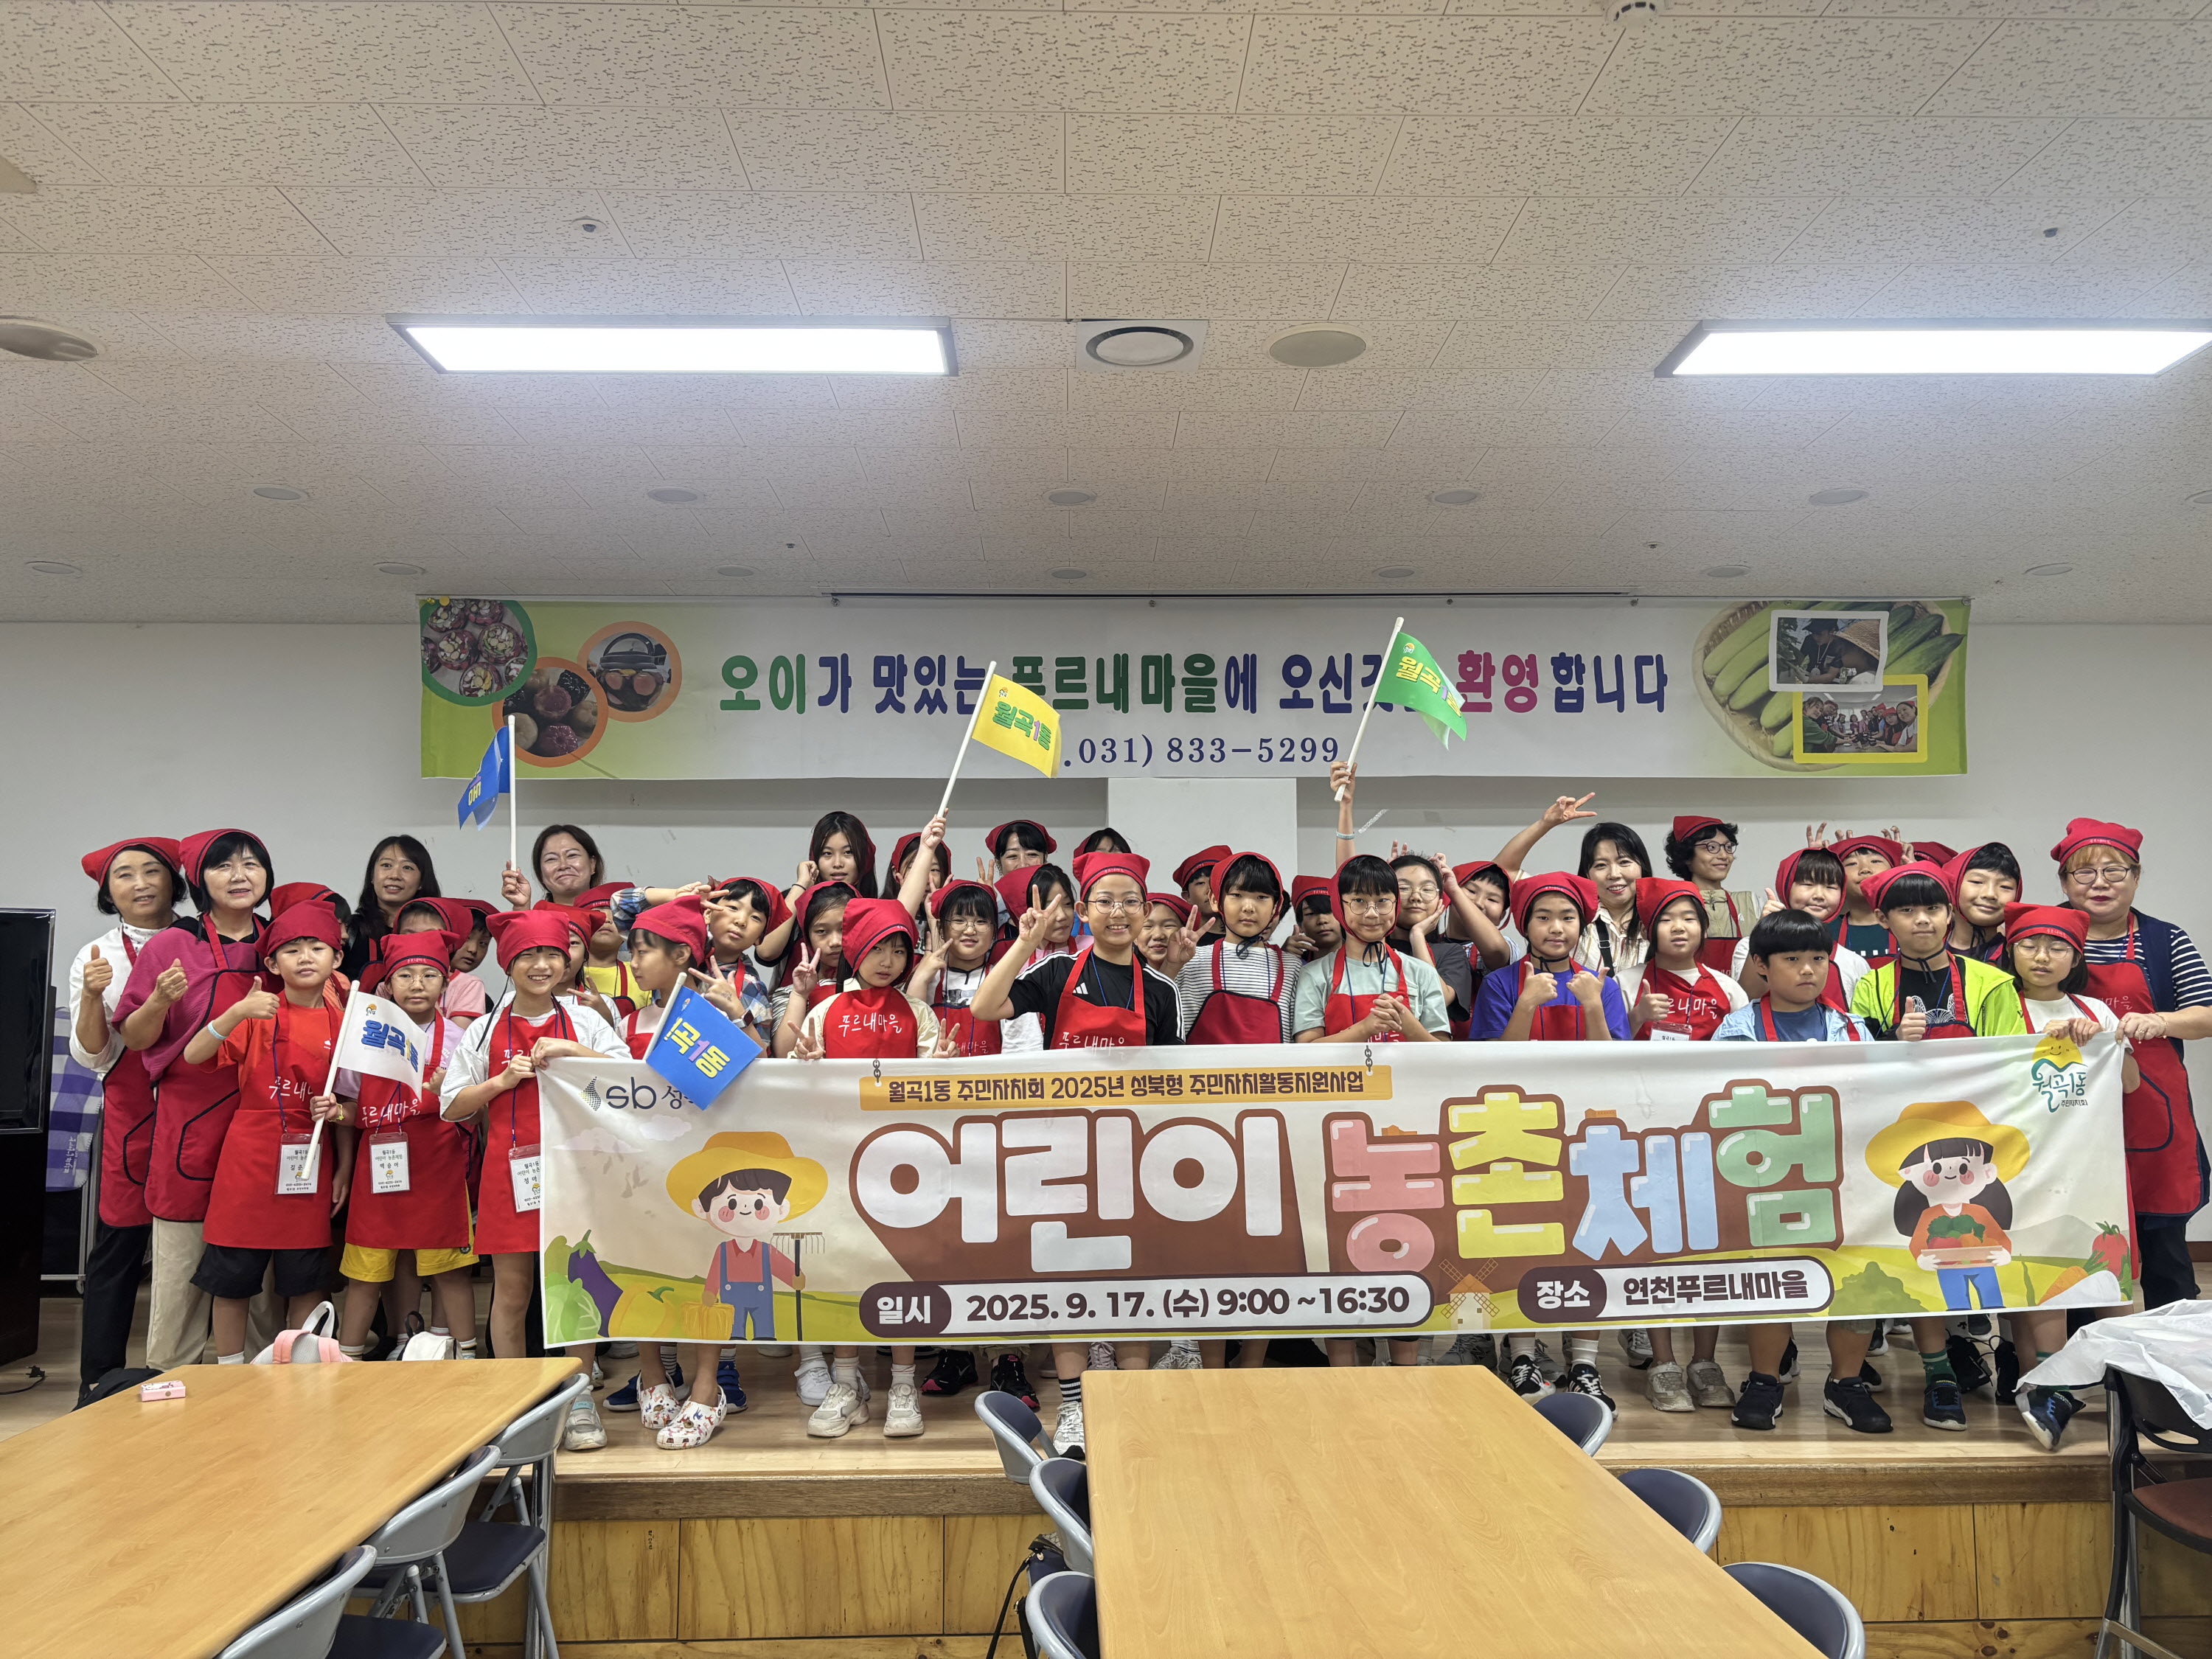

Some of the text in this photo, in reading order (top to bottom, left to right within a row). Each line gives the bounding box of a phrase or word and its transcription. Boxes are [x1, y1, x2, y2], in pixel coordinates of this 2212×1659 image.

[720, 653, 852, 714] 오이가
[872, 653, 987, 715] 맛있는
[1011, 653, 1257, 714] 푸르내마을에
[1455, 649, 1668, 714] 환영합니다
[992, 700, 1052, 751] 월곡1동
[1166, 737, 1339, 764] 833-5299
[838, 1012, 902, 1037] 푸르내마을
[1667, 998, 1718, 1020] 르내마을
[361, 1020, 419, 1073] 월곡1동
[664, 1018, 731, 1079] 곡1동
[605, 1077, 657, 1110] sb
[888, 1071, 1364, 1103] 월곡1동 주민자치회 2025년 성북형 주민자치활동지원사업
[2031, 1071, 2087, 1113] 월곡1동
[2060, 1099, 2088, 1107] 주민자치회
[361, 1098, 421, 1129] 푸르내마을
[855, 1085, 1838, 1273] 어린이 농촌체험
[875, 1295, 931, 1325] 일시
[965, 1294, 1059, 1322] 2025.
[1066, 1293, 1096, 1320] 9.
[1106, 1291, 1155, 1318] 17.
[1162, 1287, 1209, 1319] (수)
[1536, 1268, 1810, 1310] 장소 연천푸르내마을
